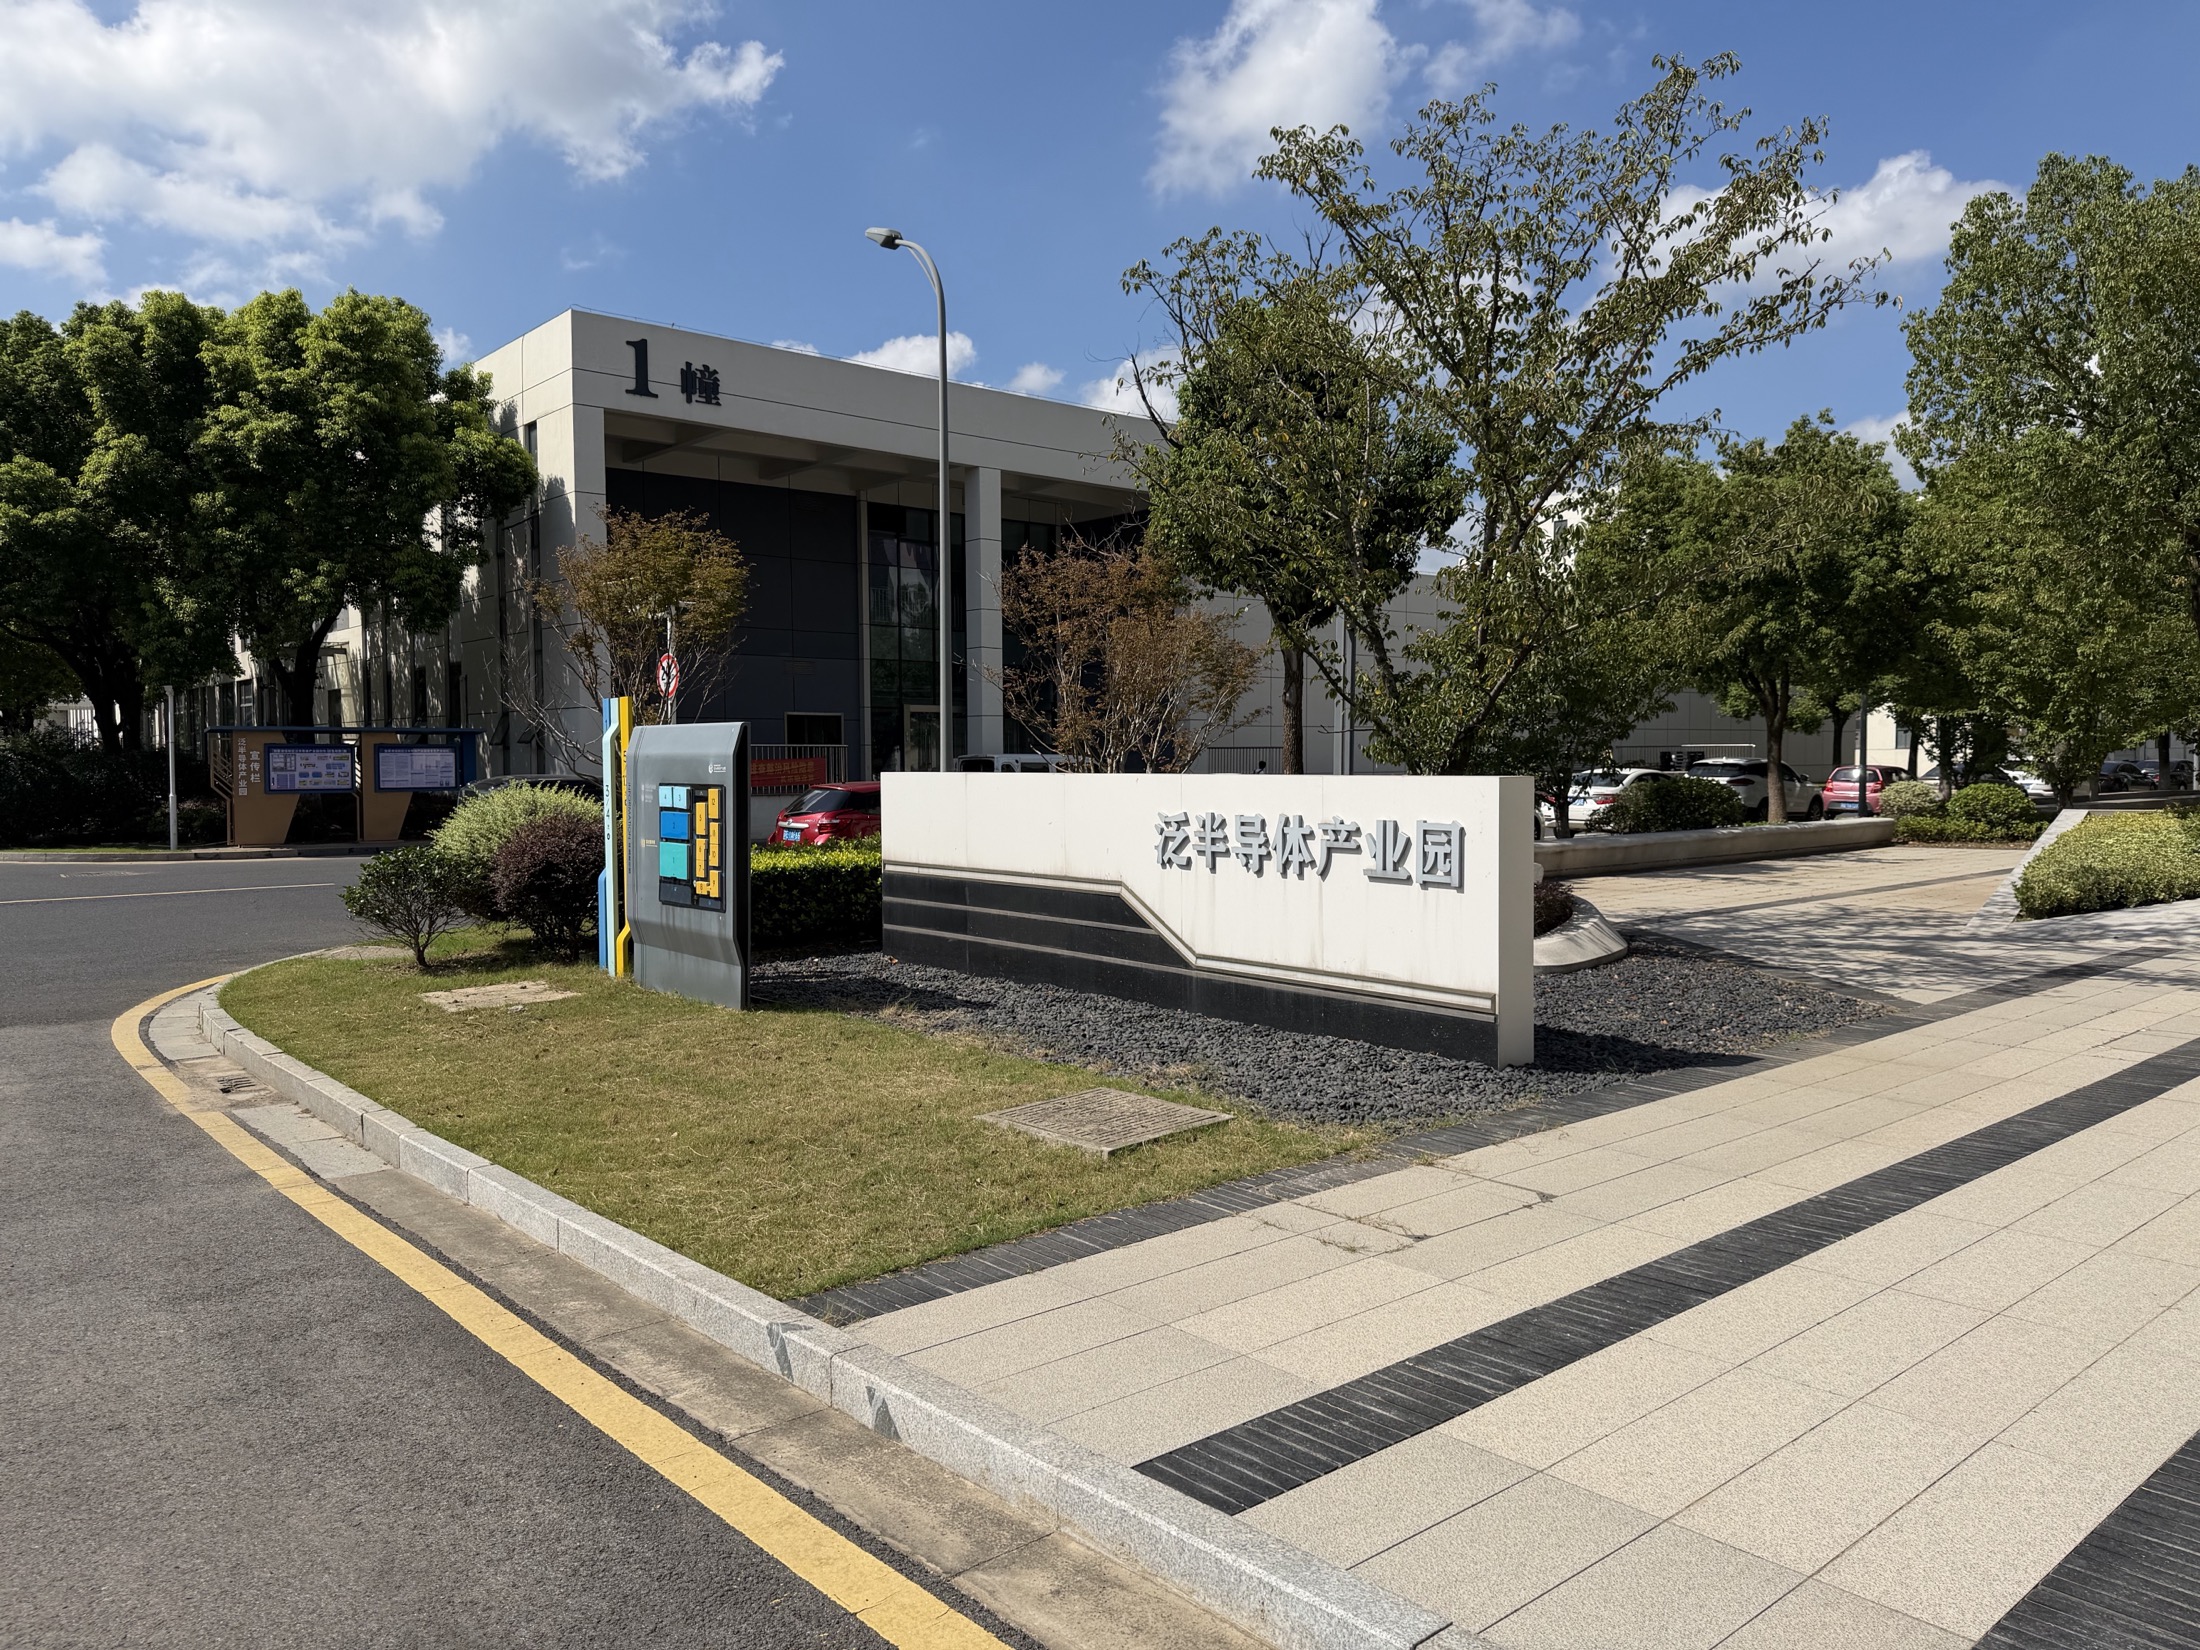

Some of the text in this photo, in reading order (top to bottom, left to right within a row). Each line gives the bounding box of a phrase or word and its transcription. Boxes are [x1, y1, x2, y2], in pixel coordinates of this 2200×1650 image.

[237, 737, 248, 796] 泛半导体产业园
[249, 750, 261, 783] 宣传栏
[1154, 811, 1466, 893] 泛半导体产业园
